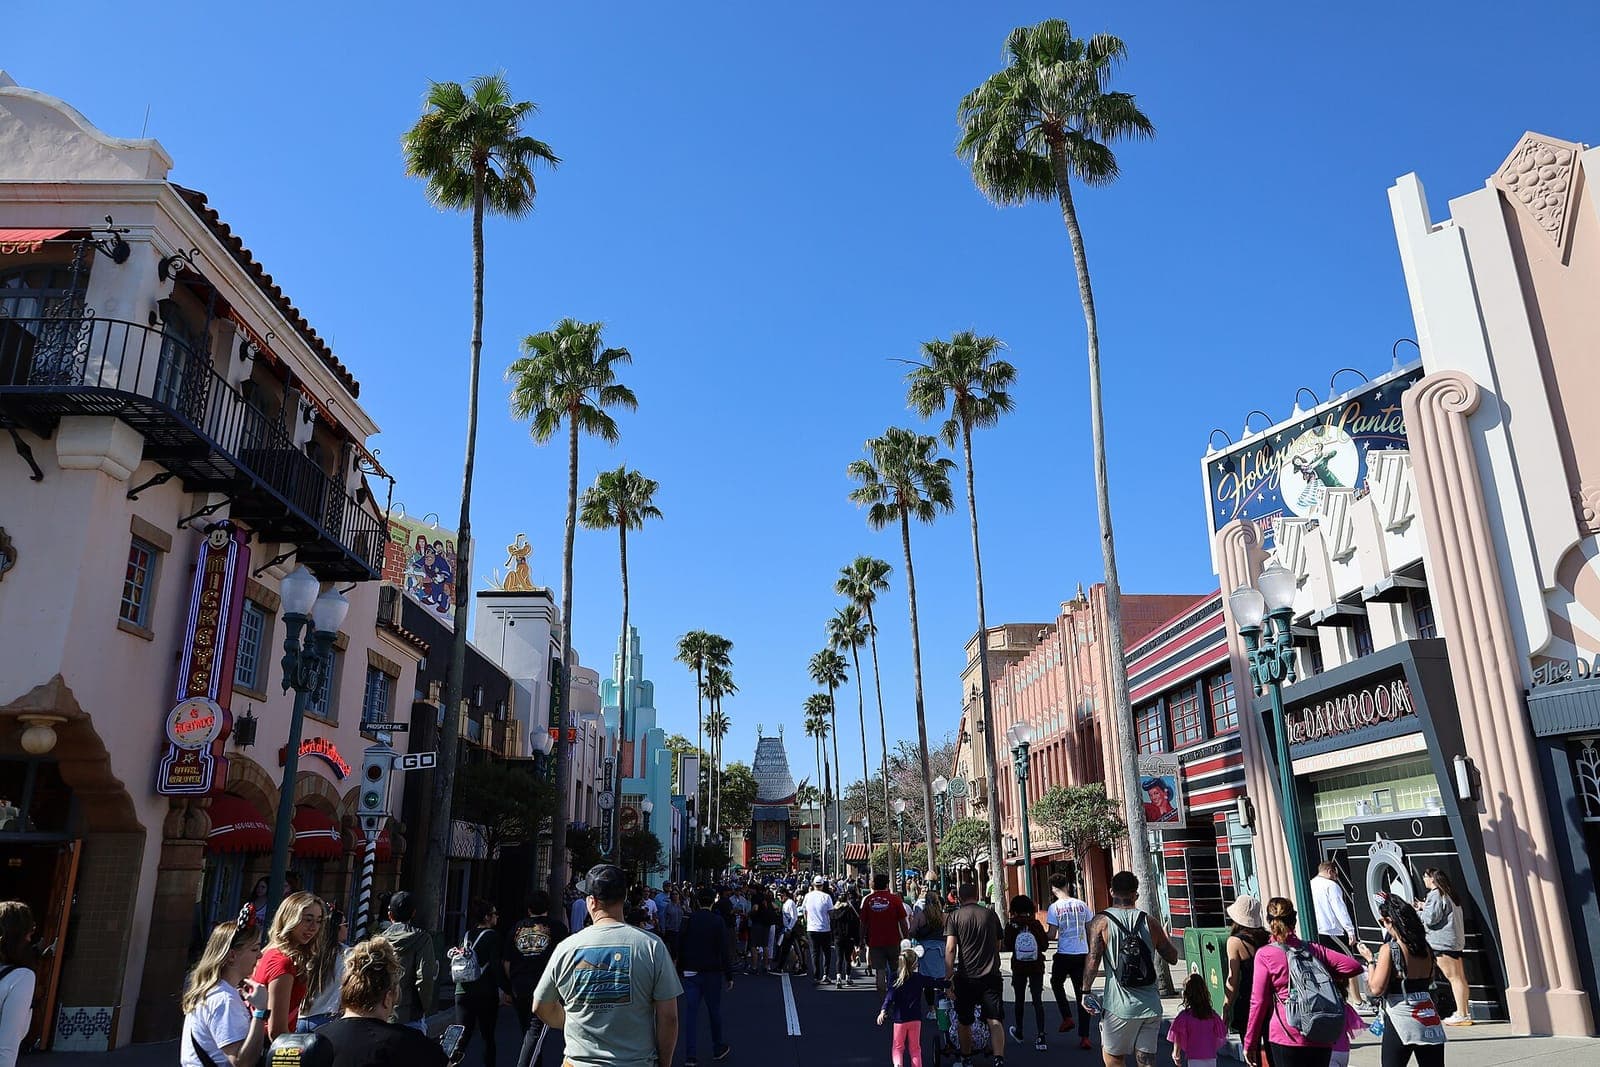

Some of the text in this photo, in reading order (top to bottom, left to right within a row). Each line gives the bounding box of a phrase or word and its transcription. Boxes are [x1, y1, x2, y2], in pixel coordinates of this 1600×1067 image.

[1533, 660, 1570, 686] The
[1285, 679, 1412, 743] he DARKROOM
[403, 754, 435, 768] GO
